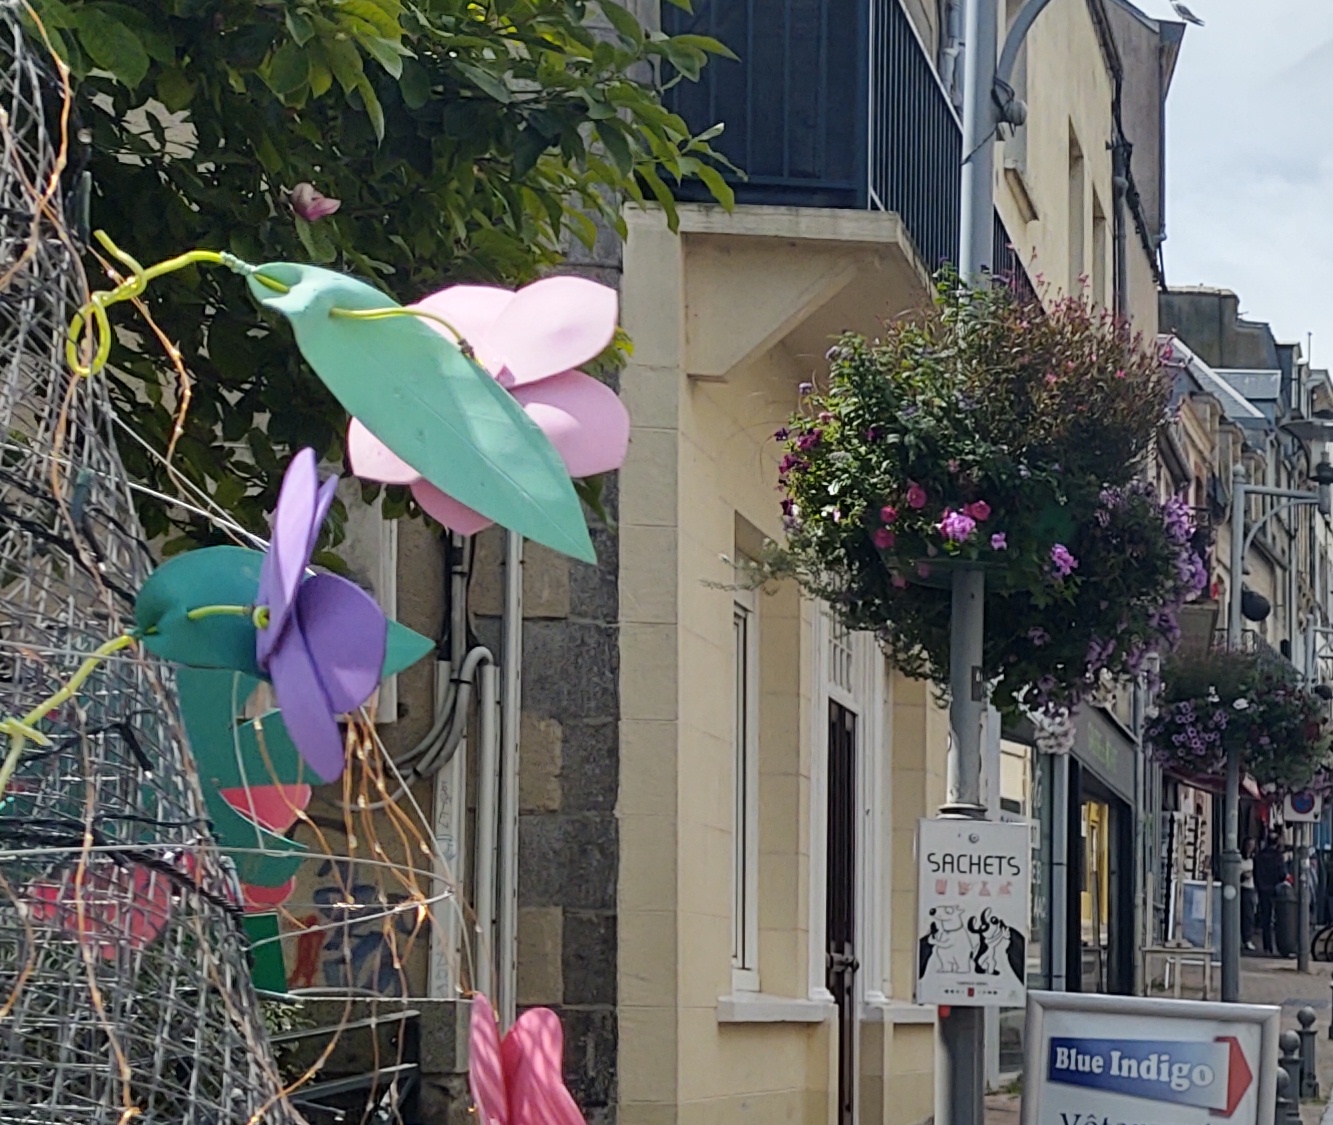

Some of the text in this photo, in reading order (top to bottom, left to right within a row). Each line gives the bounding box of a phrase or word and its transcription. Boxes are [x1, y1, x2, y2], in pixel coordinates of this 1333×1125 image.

[927, 852, 1021, 876] SACHETS
[1055, 1047, 1216, 1092] Blue Indigo
